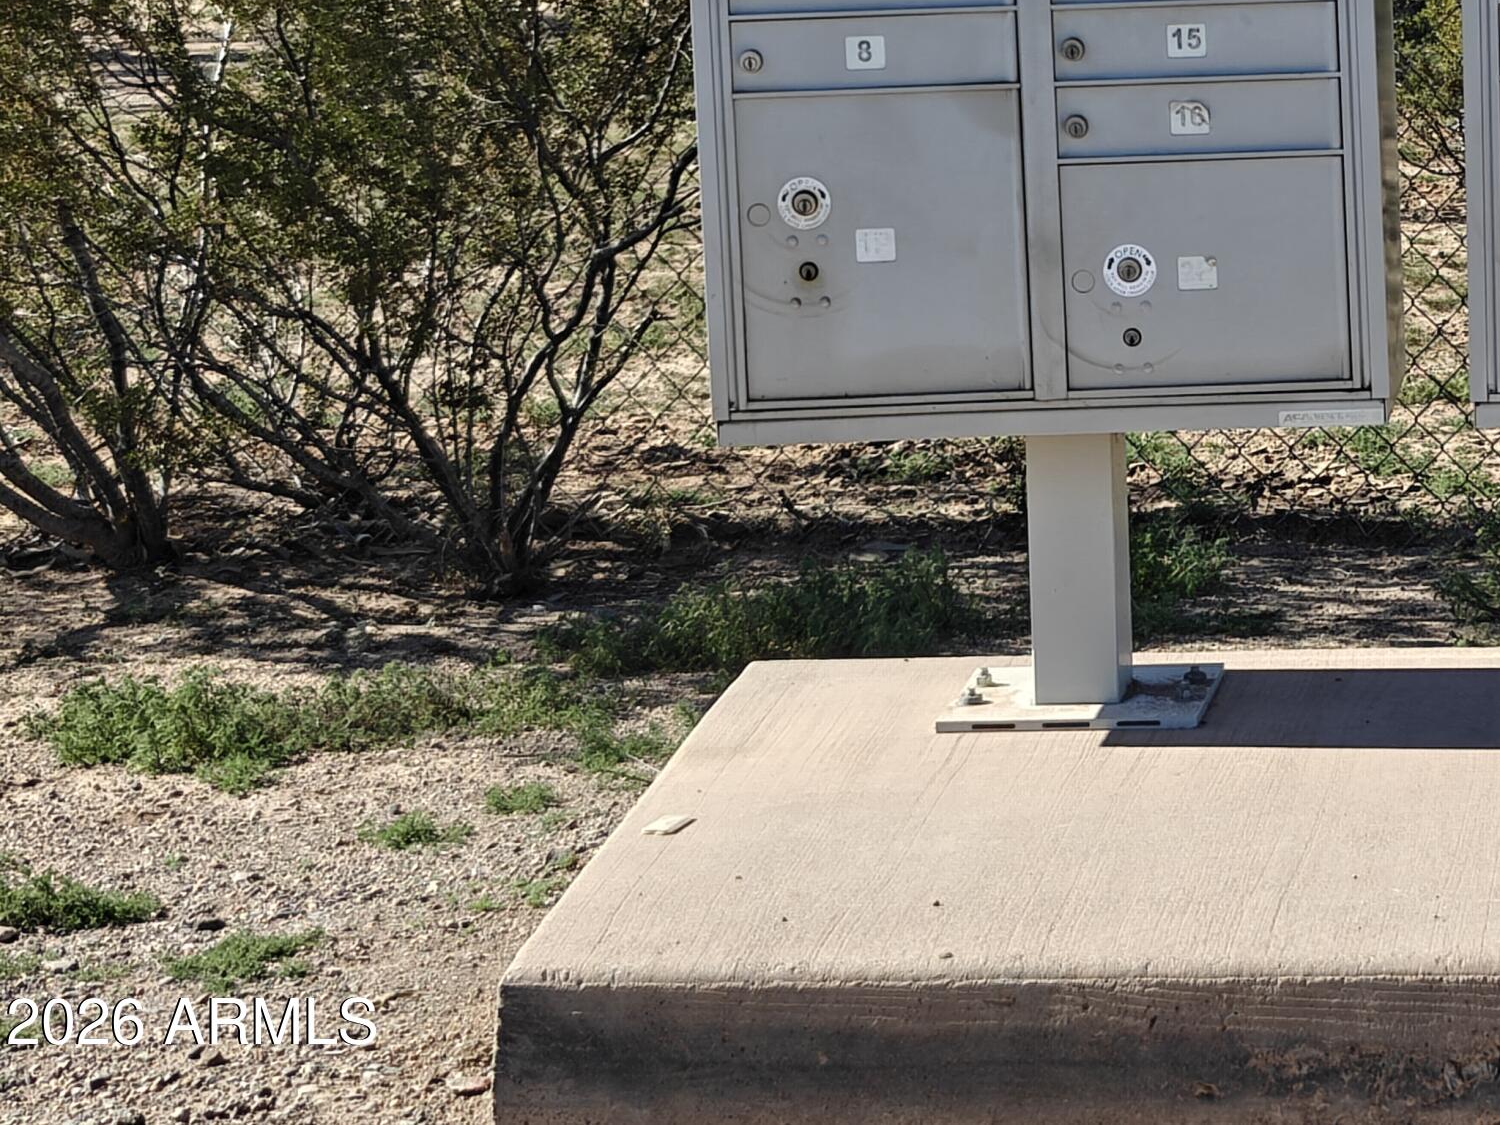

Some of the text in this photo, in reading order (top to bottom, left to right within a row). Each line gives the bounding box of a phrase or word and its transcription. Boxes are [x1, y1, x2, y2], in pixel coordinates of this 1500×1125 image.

[1172, 28, 1202, 51] 15
[857, 40, 873, 63] 8
[1114, 246, 1143, 259] OPEN
